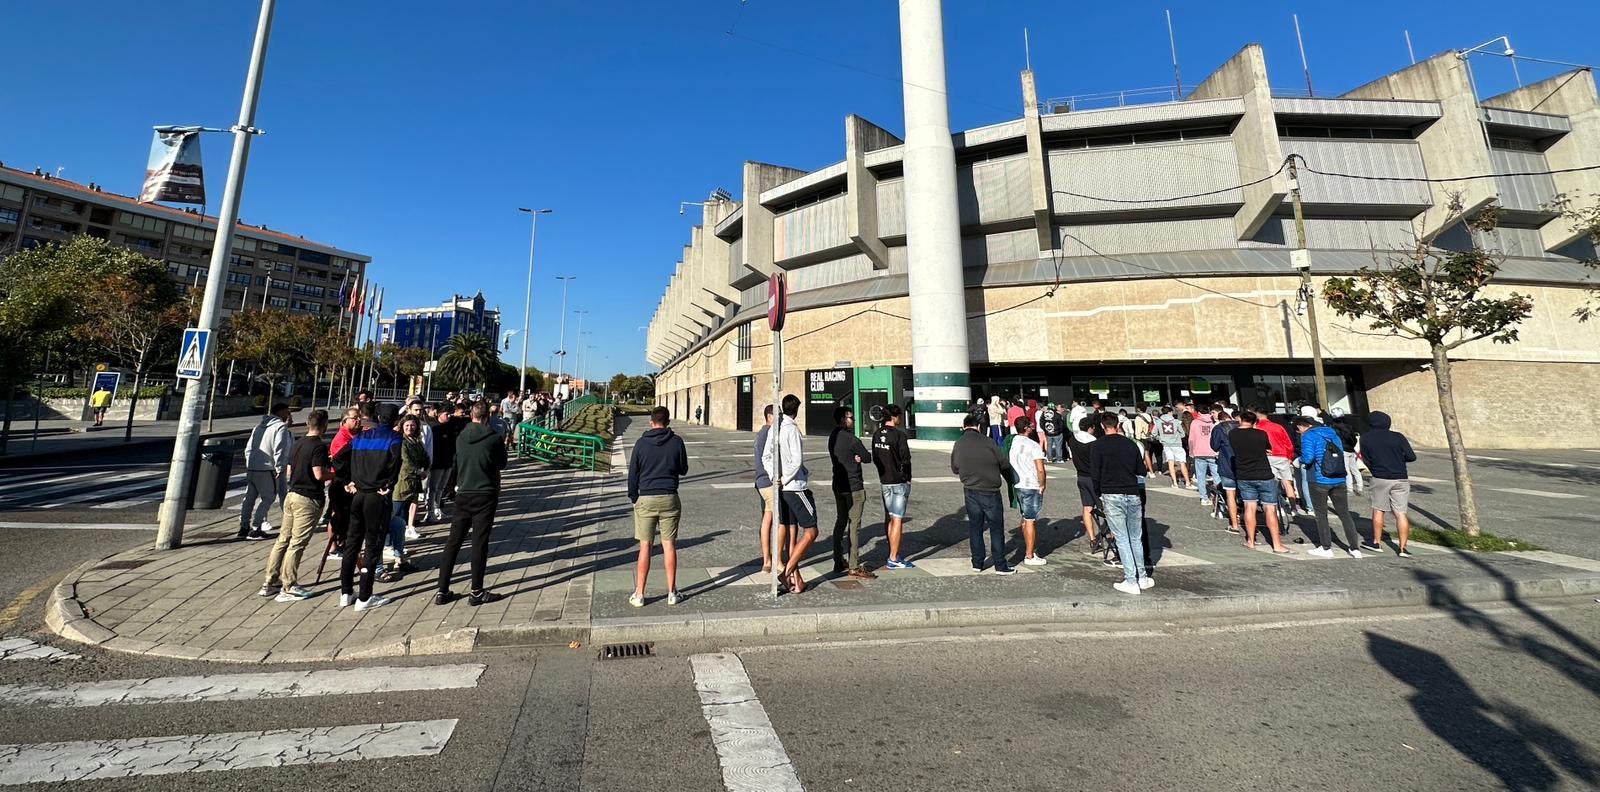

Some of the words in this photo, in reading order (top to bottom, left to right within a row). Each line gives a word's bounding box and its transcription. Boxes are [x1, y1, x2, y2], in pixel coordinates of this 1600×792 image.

[810, 372, 824, 381] REAL
[824, 371, 845, 381] RACING
[810, 382, 824, 391] CLUB
